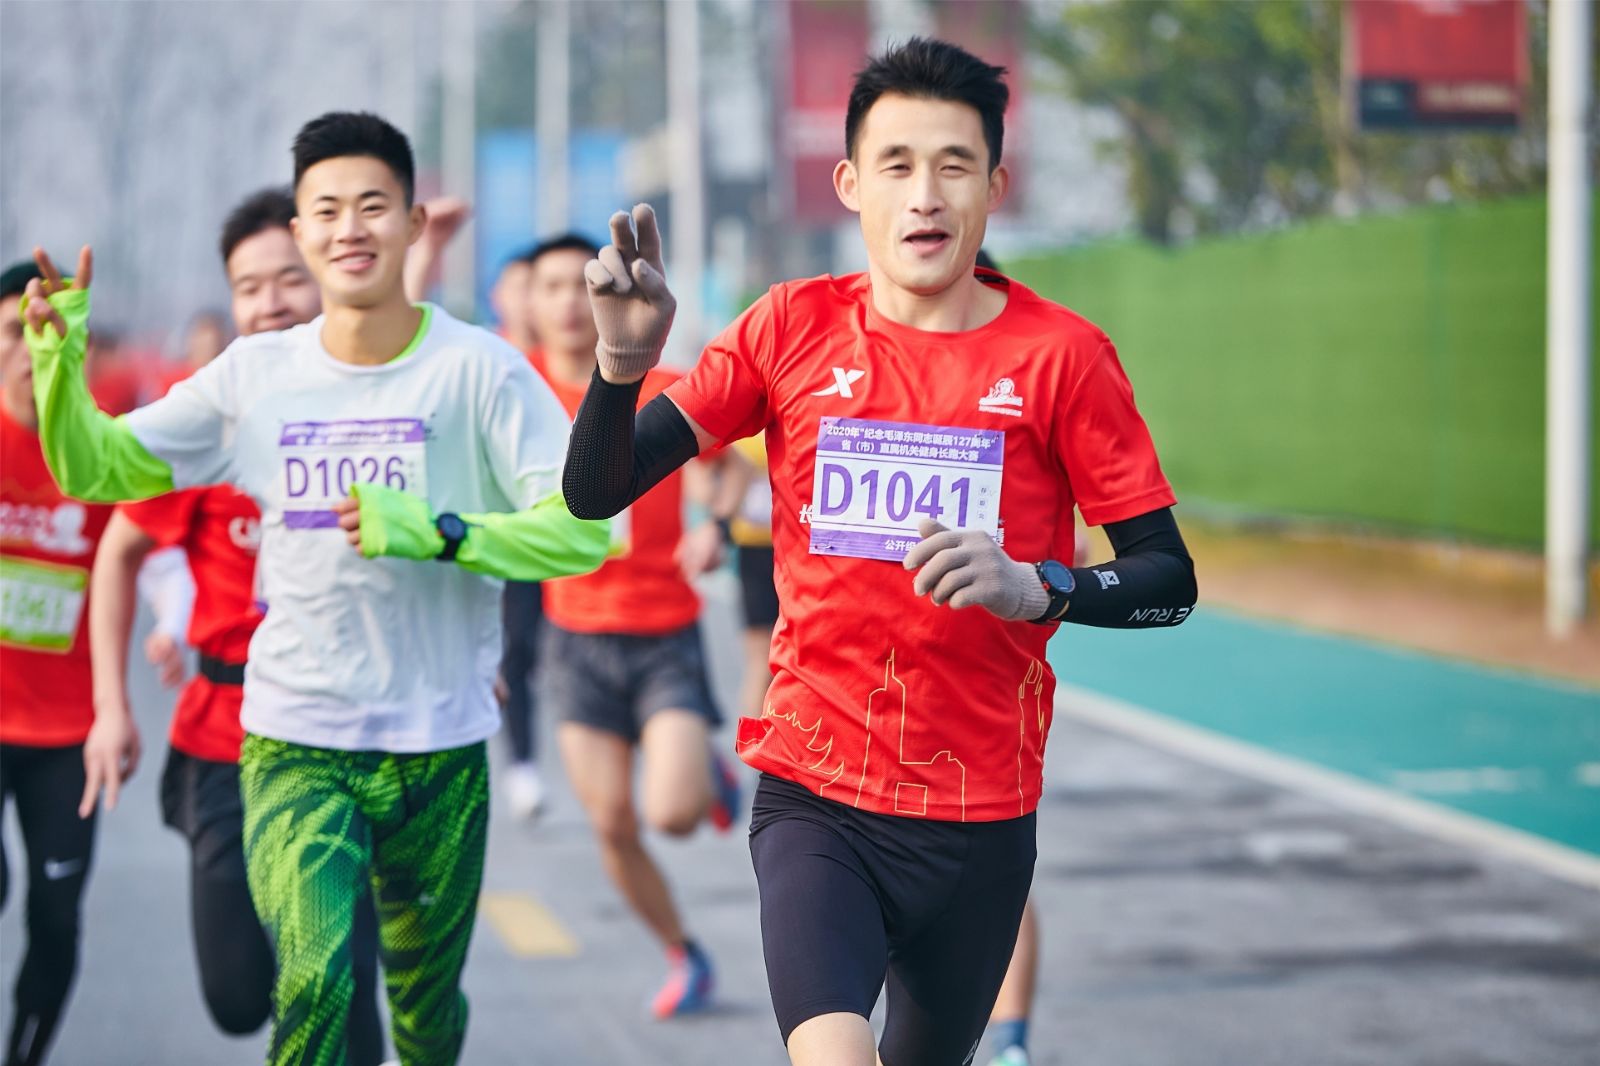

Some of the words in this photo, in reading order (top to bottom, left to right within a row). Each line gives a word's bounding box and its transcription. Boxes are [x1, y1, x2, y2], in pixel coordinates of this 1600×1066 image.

[286, 456, 406, 498] D1026
[820, 463, 970, 527] D1041
[1127, 607, 1174, 622] RUN
